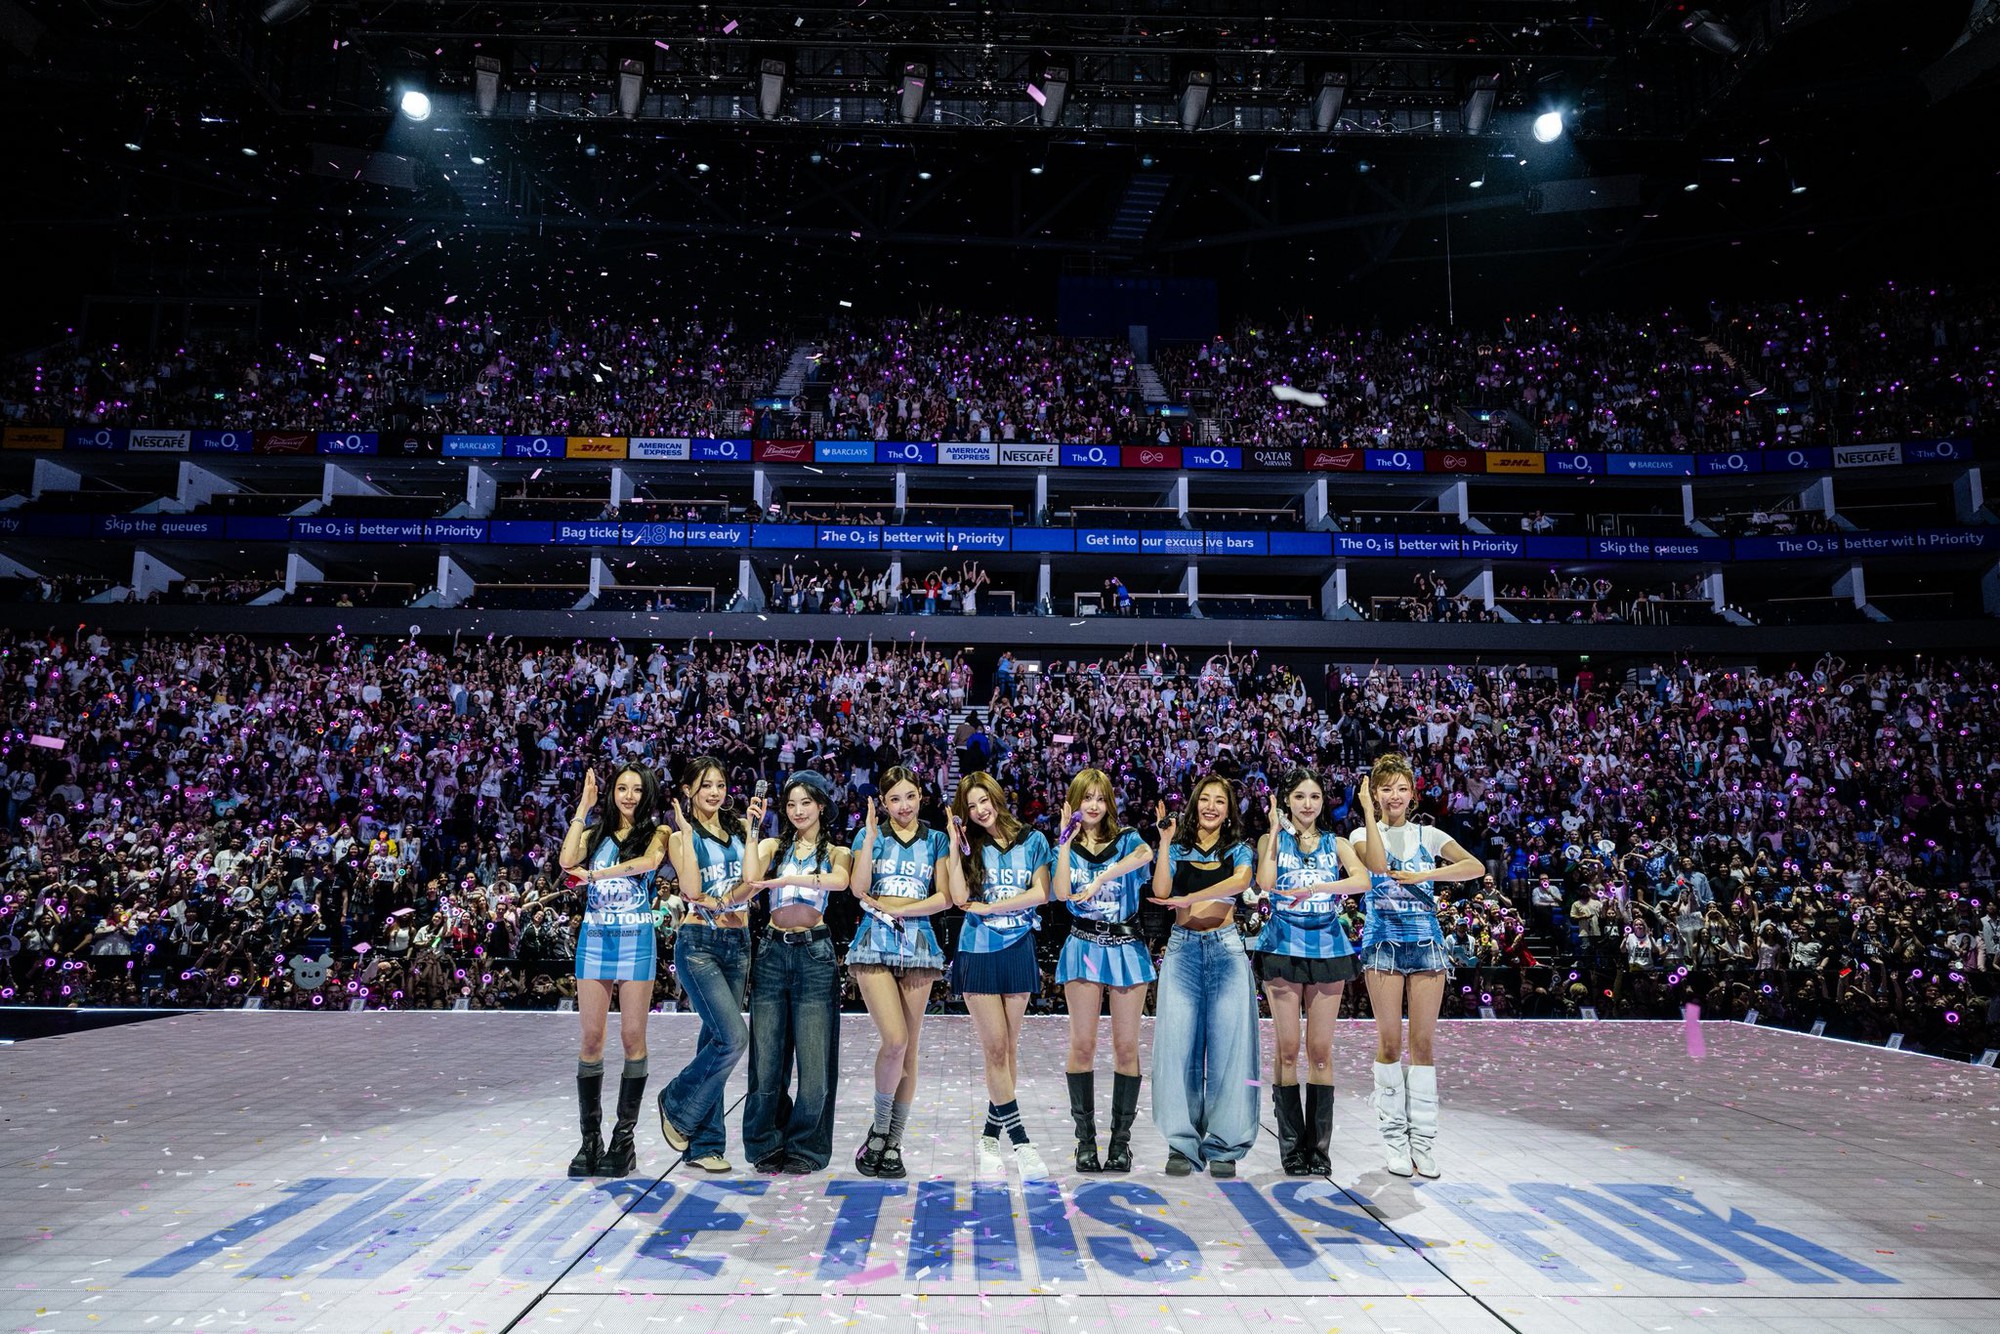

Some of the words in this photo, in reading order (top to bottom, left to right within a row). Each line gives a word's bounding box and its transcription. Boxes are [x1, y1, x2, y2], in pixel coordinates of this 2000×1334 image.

[132, 433, 185, 449] NESCAFÉ
[203, 439, 219, 448] The
[458, 442, 496, 451] BARCLAYS
[638, 442, 683, 451] AMERICAN
[516, 444, 531, 453] The
[643, 449, 683, 457] EXPRESS
[703, 447, 719, 456] The
[831, 447, 868, 456] BARCLAYS
[888, 450, 904, 459] The
[1003, 448, 1054, 462] NESCAFÉ
[1838, 446, 1895, 464] NESCAFÉ
[952, 453, 990, 461] EXPRESS
[1072, 454, 1088, 462] The
[1193, 456, 1209, 464] The
[1254, 451, 1292, 462] QATAR
[1376, 458, 1392, 467] The
[1557, 461, 1573, 470] The
[1637, 461, 1673, 469] BARCLAYS
[1709, 461, 1727, 470] The
[105, 519, 132, 534] Skip
[135, 519, 156, 531] the
[161, 522, 208, 534] queues
[299, 522, 322, 534] The
[344, 523, 355, 534] is
[359, 523, 399, 535] better
[401, 524, 432, 536] with
[435, 524, 483, 539] Priority
[562, 527, 586, 540] Bag
[589, 526, 634, 538] tickets
[635, 524, 667, 544] 48
[669, 528, 706, 540] hours
[709, 529, 741, 543] early
[824, 531, 847, 542] The
[868, 531, 879, 542] is
[883, 532, 923, 543] better
[925, 532, 954, 544] with
[958, 532, 1005, 546] Priority
[1086, 534, 1109, 545] Get
[1112, 534, 1137, 546] into
[1141, 537, 1162, 547] our
[1227, 536, 1254, 548] bars
[1340, 538, 1363, 549] The
[1384, 538, 1395, 549] is
[1399, 538, 1438, 550] better
[1440, 539, 1470, 551] with
[1472, 540, 1519, 554] Priority
[1777, 541, 1803, 552] The
[1827, 539, 1838, 550] is
[1844, 537, 1888, 549] better
[1891, 534, 1926, 547] with
[1930, 532, 1984, 545] Priority
[1600, 542, 1627, 555] Skip
[1628, 542, 1650, 553] the
[1654, 545, 1699, 556] queues
[1278, 852, 1300, 870] HIS
[730, 860, 742, 877] IS
[900, 860, 916, 876] IS
[920, 862, 933, 879] FO
[1001, 868, 1013, 884] IS
[1017, 869, 1031, 885] FO
[617, 912, 653, 925] TOUR
[816, 1178, 1202, 1282] THIS
[1214, 1180, 1450, 1282] IS
[1409, 1181, 1902, 1285] FOR
